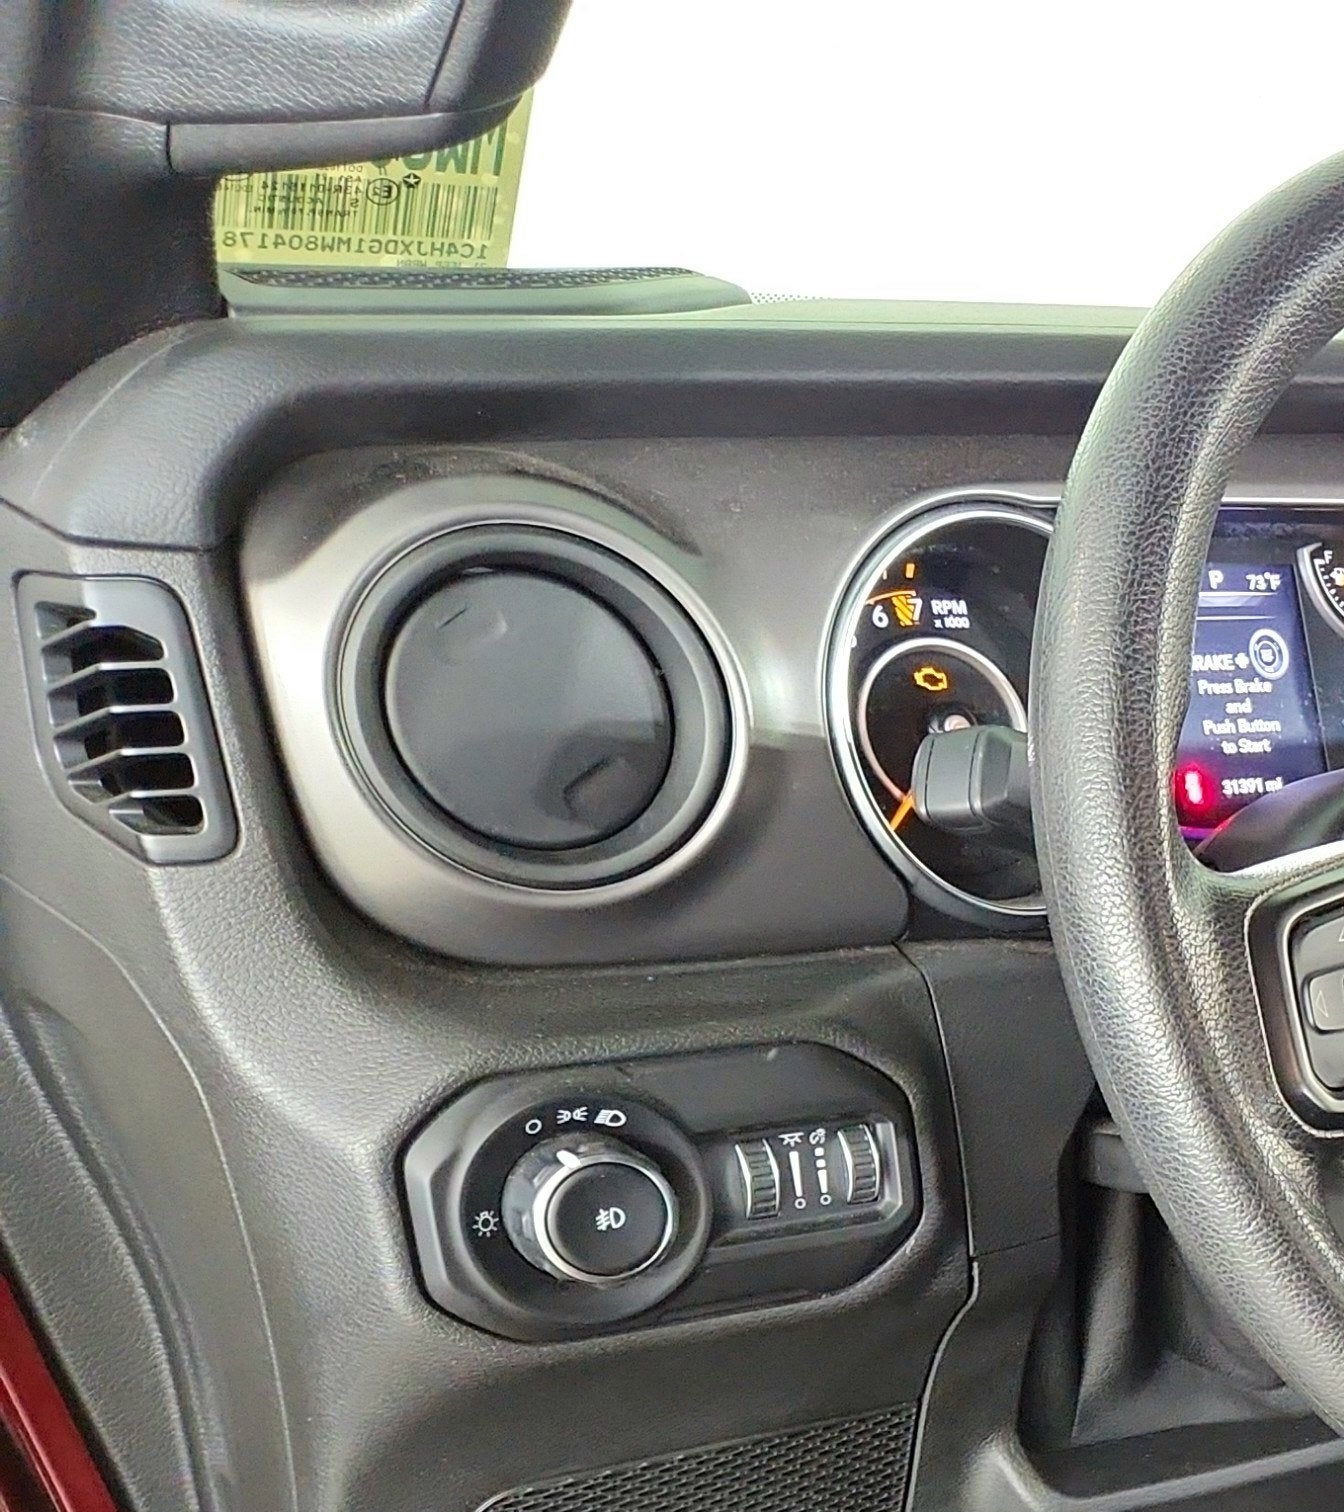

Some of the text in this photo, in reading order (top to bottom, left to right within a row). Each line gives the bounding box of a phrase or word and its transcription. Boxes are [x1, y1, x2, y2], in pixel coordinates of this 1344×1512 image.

[1323, 550, 1333, 563] F
[1208, 570, 1281, 591] P 73°F
[871, 604, 889, 628] 6
[907, 598, 923, 622] 7
[931, 599, 969, 616] RPM
[944, 616, 970, 629] 1000
[1191, 653, 1236, 671] RAKE
[1197, 677, 1273, 695] Press Brake
[1225, 698, 1252, 714] and
[1202, 718, 1282, 736] Push Button
[1221, 737, 1272, 755] to Start
[1264, 776, 1283, 792] mi
